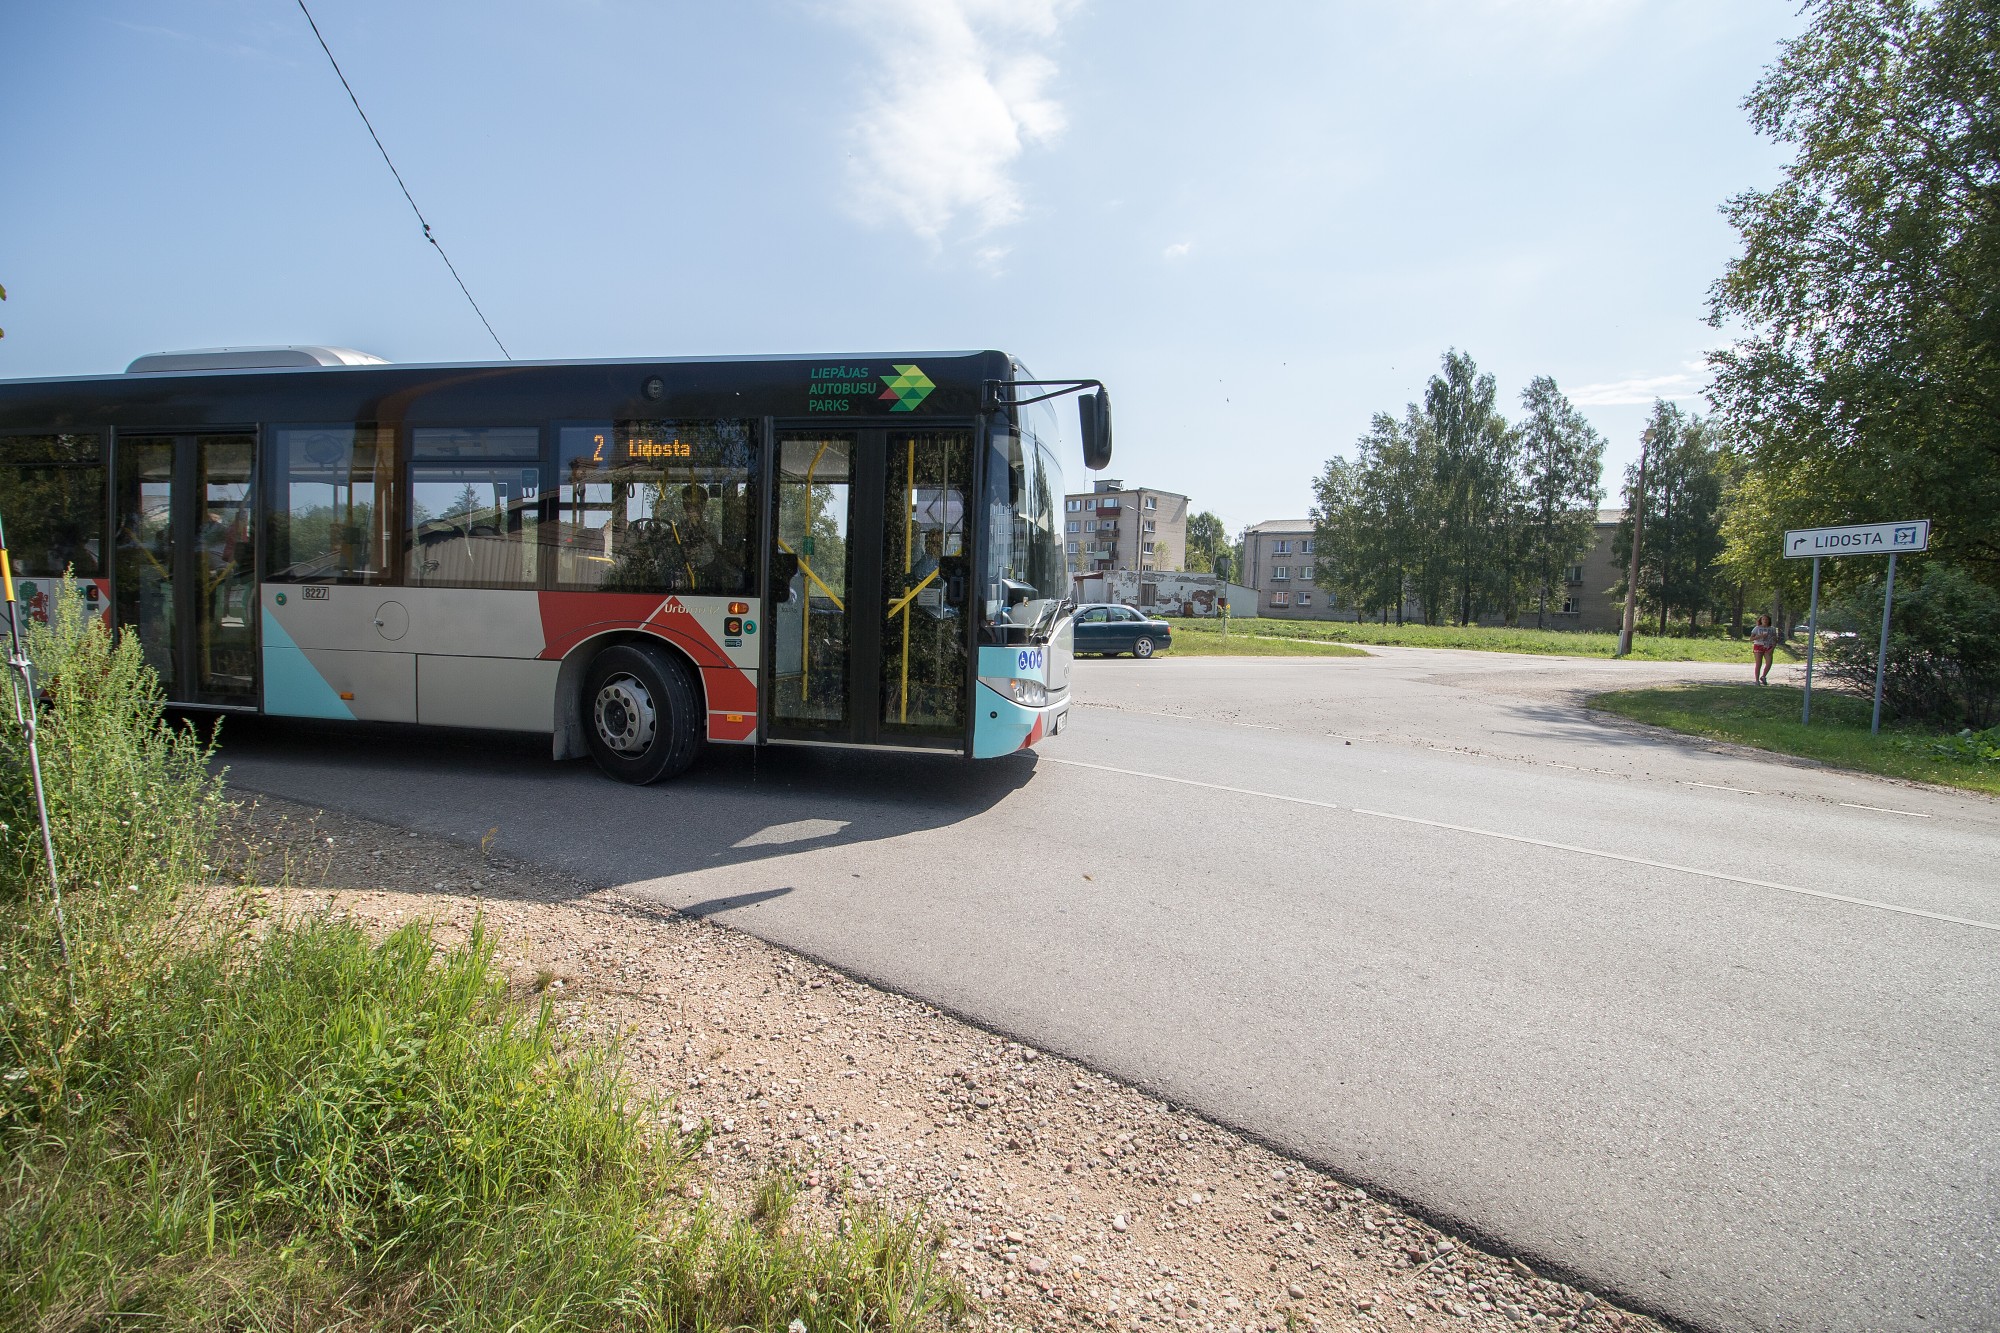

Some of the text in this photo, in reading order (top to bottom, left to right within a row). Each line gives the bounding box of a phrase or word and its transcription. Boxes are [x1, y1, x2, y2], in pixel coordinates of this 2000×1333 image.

[811, 366, 869, 379] LIEPĀJAS
[809, 382, 877, 395] AUTOBUSU
[809, 399, 850, 412] PARKS
[593, 434, 690, 461] 2 Lidosta
[1815, 532, 1883, 549] LIDOSTA
[305, 587, 327, 598] 8227
[664, 603, 706, 614] Urbino
